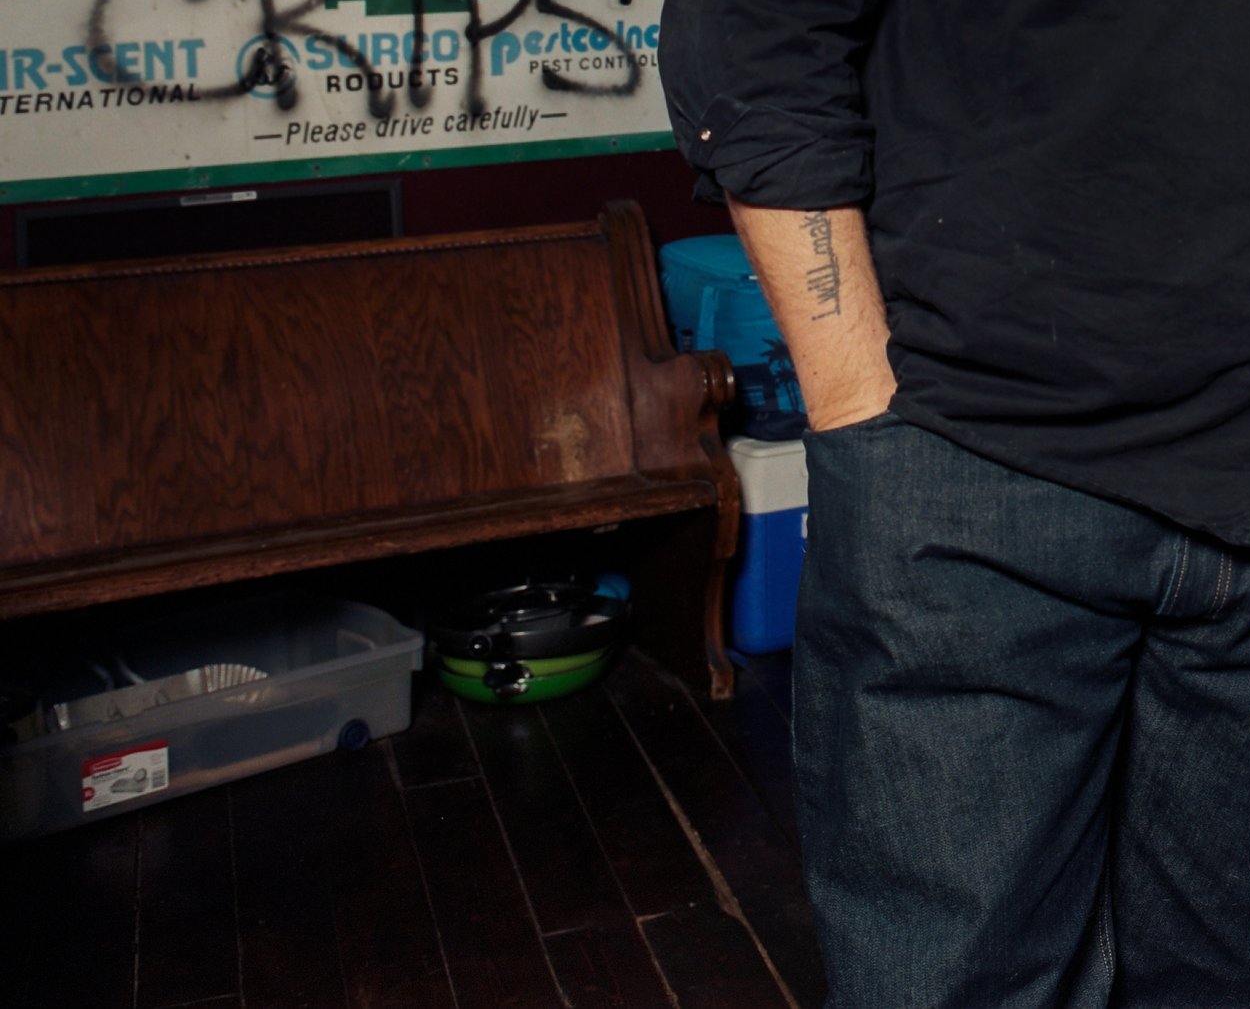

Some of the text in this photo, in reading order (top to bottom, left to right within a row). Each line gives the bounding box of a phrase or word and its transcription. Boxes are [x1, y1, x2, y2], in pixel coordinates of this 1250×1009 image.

[304, 29, 460, 71] SURCO
[579, 53, 658, 72] CONTOL
[375, 112, 434, 140] drive
